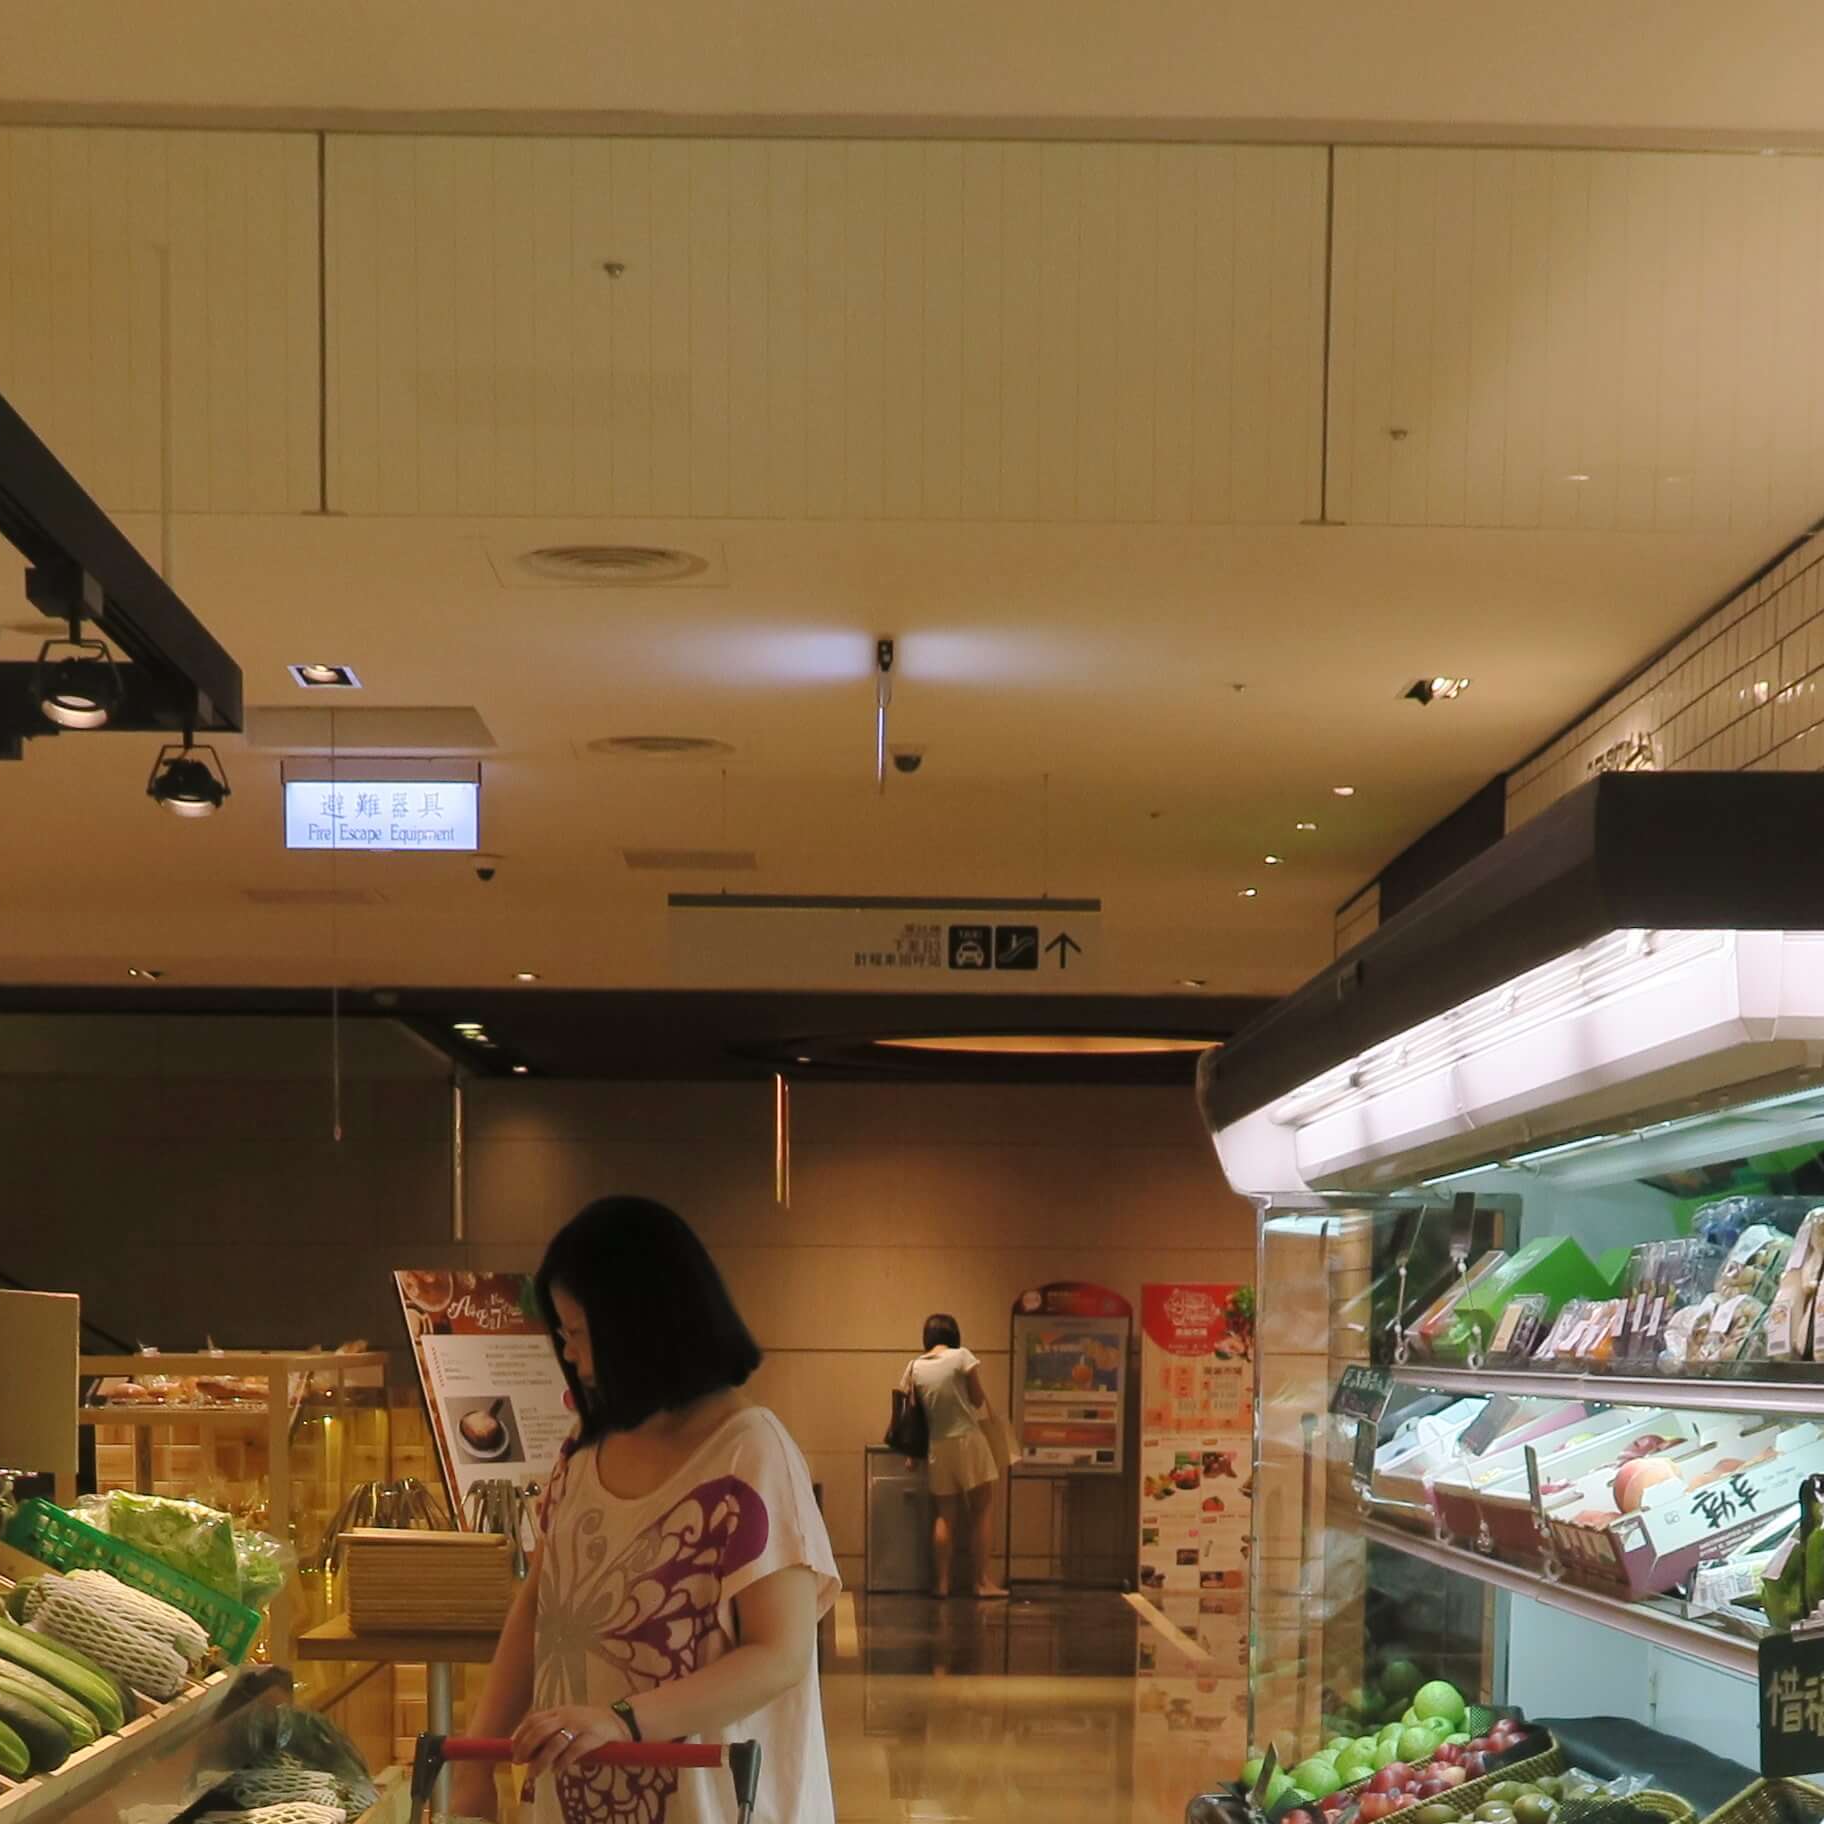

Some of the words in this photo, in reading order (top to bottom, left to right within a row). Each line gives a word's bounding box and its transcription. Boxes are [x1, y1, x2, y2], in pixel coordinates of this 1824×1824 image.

[320, 792, 444, 818] 避難器具
[308, 823, 331, 841] Fire
[339, 823, 382, 844] Escape
[390, 823, 455, 845] Equipment
